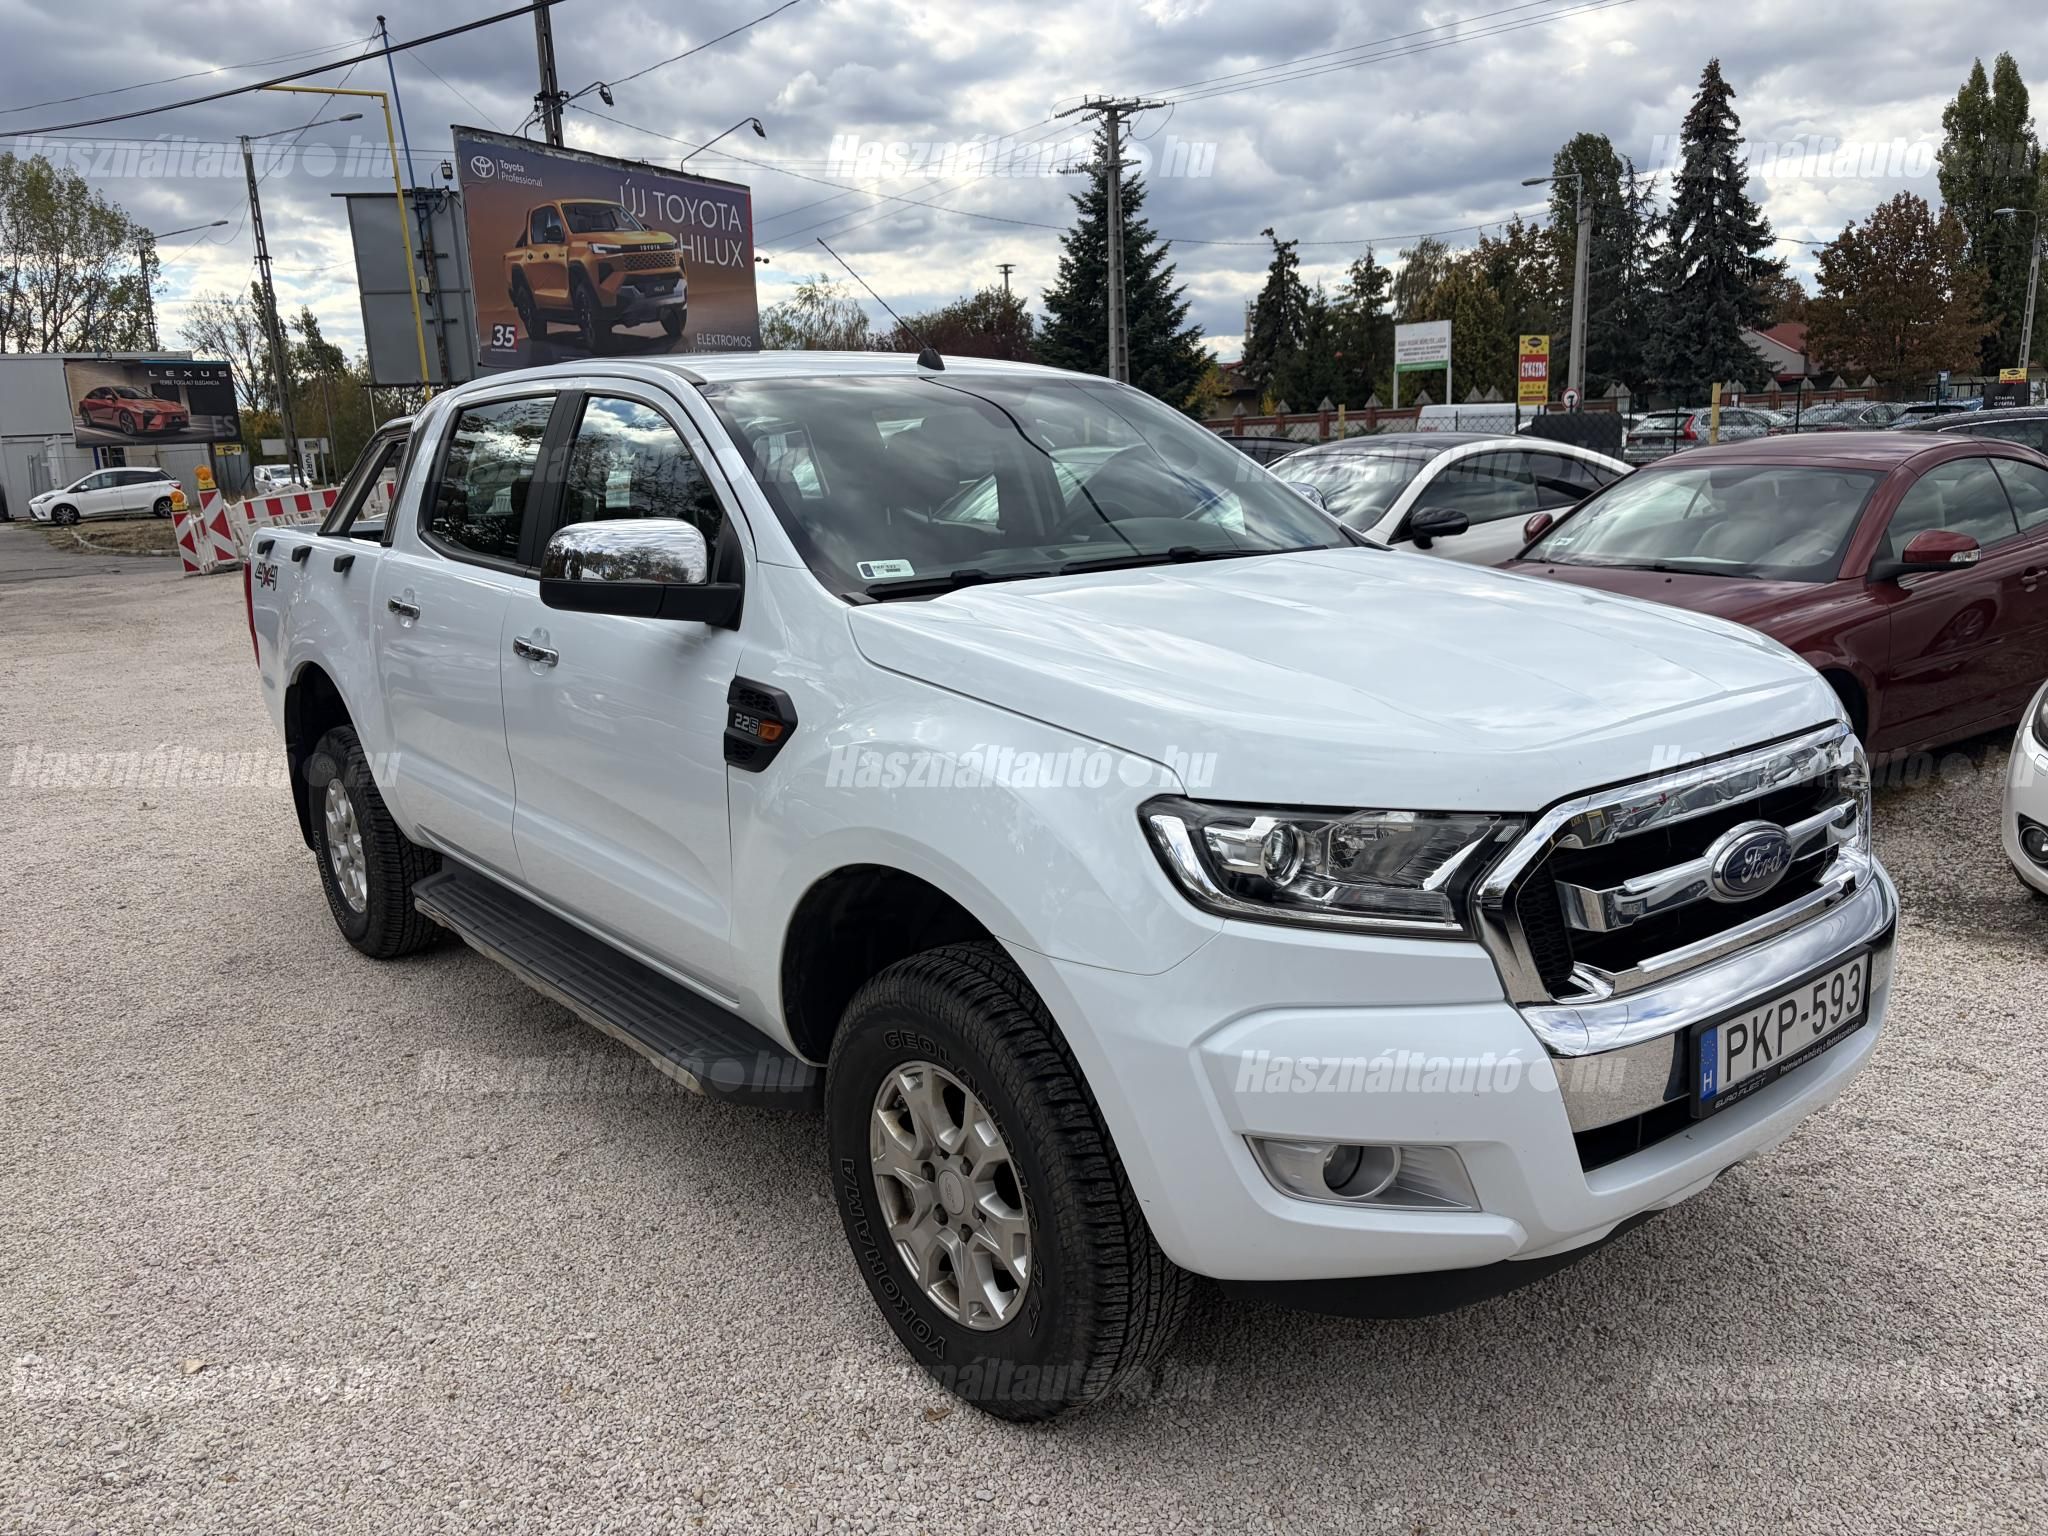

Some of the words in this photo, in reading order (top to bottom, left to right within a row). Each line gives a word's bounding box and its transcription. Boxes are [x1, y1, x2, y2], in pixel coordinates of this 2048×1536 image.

[500, 160, 525, 172] Toyota
[501, 171, 543, 187] Professional
[619, 178, 647, 223] ÚJ
[653, 190, 743, 233] TOYOTA
[679, 232, 745, 268] HILUX
[492, 325, 516, 348] 35
[696, 332, 752, 348] ELEKTROMOS
[212, 415, 237, 437] ES
[1741, 841, 1783, 884] Ford
[1725, 963, 1861, 1083] PKP-593
[1703, 1069, 1713, 1092] H
[840, 1158, 946, 1360] YOKOHAMA
